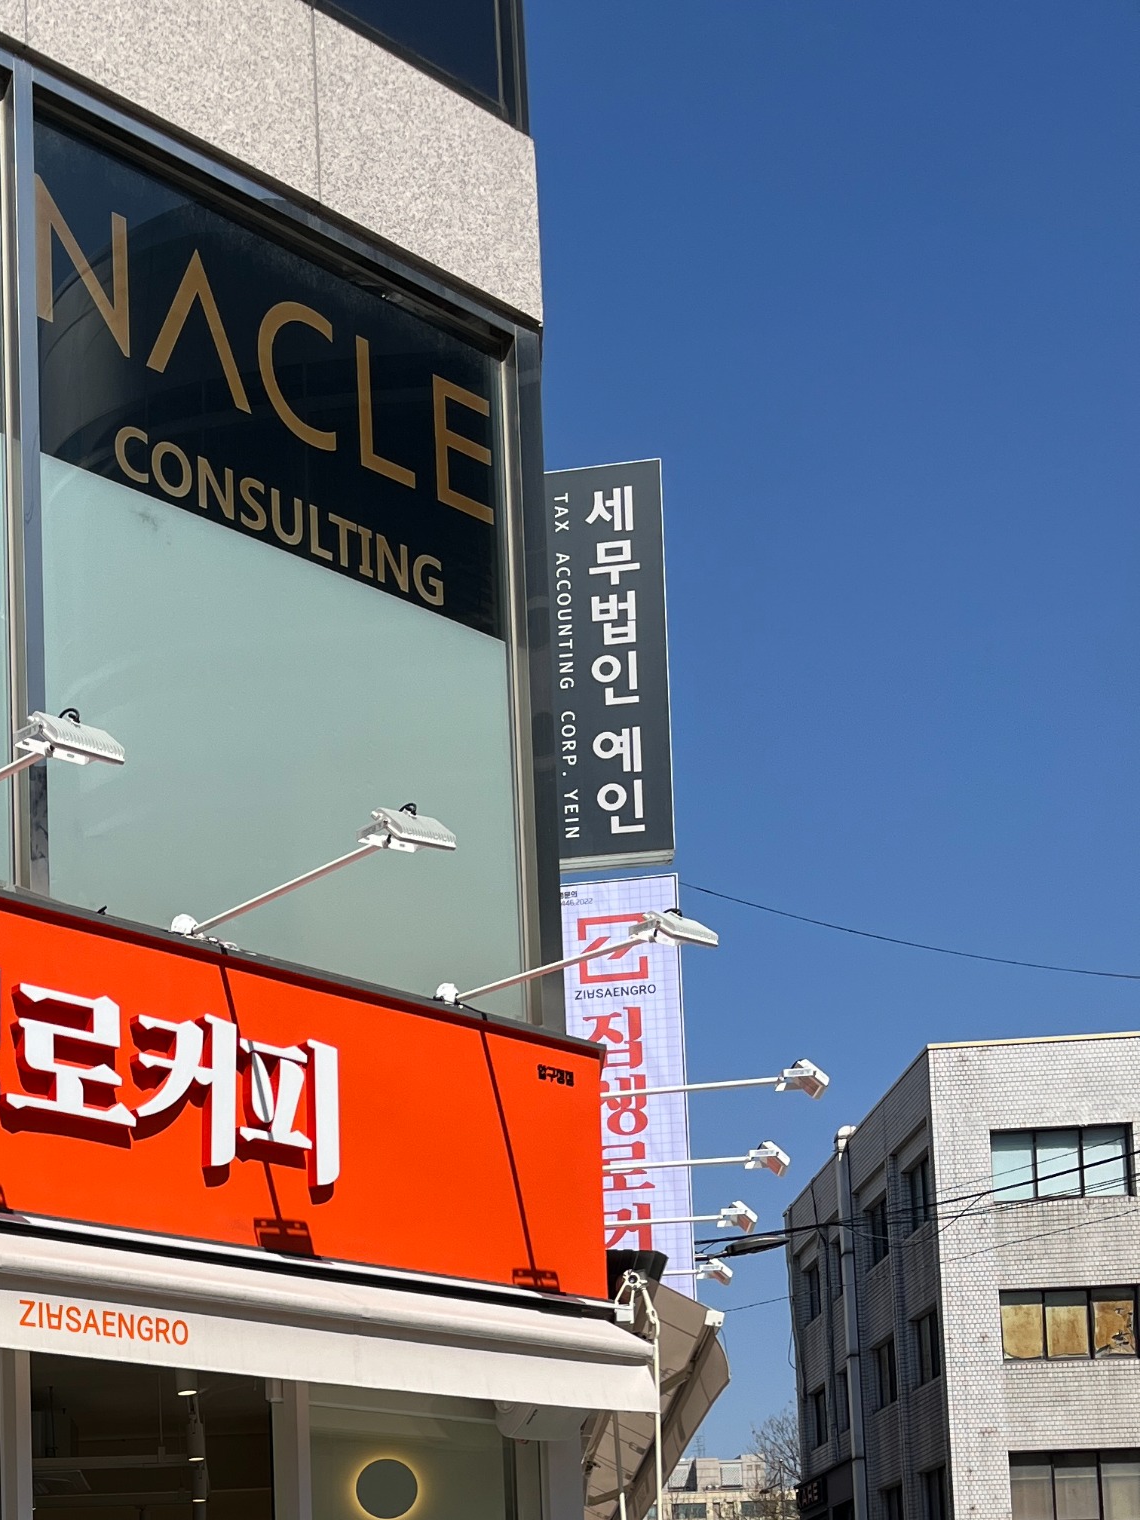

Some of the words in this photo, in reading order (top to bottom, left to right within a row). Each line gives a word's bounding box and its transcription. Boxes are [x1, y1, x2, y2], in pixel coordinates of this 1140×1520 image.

[115, 426, 445, 606] CONSULTING
[553, 493, 569, 533] TAX
[555, 553, 574, 690] ACCOUNTING
[585, 485, 640, 706] 세무법인
[560, 710, 577, 777] CORP.
[592, 726, 645, 834] 예인
[563, 789, 580, 839] YEIN
